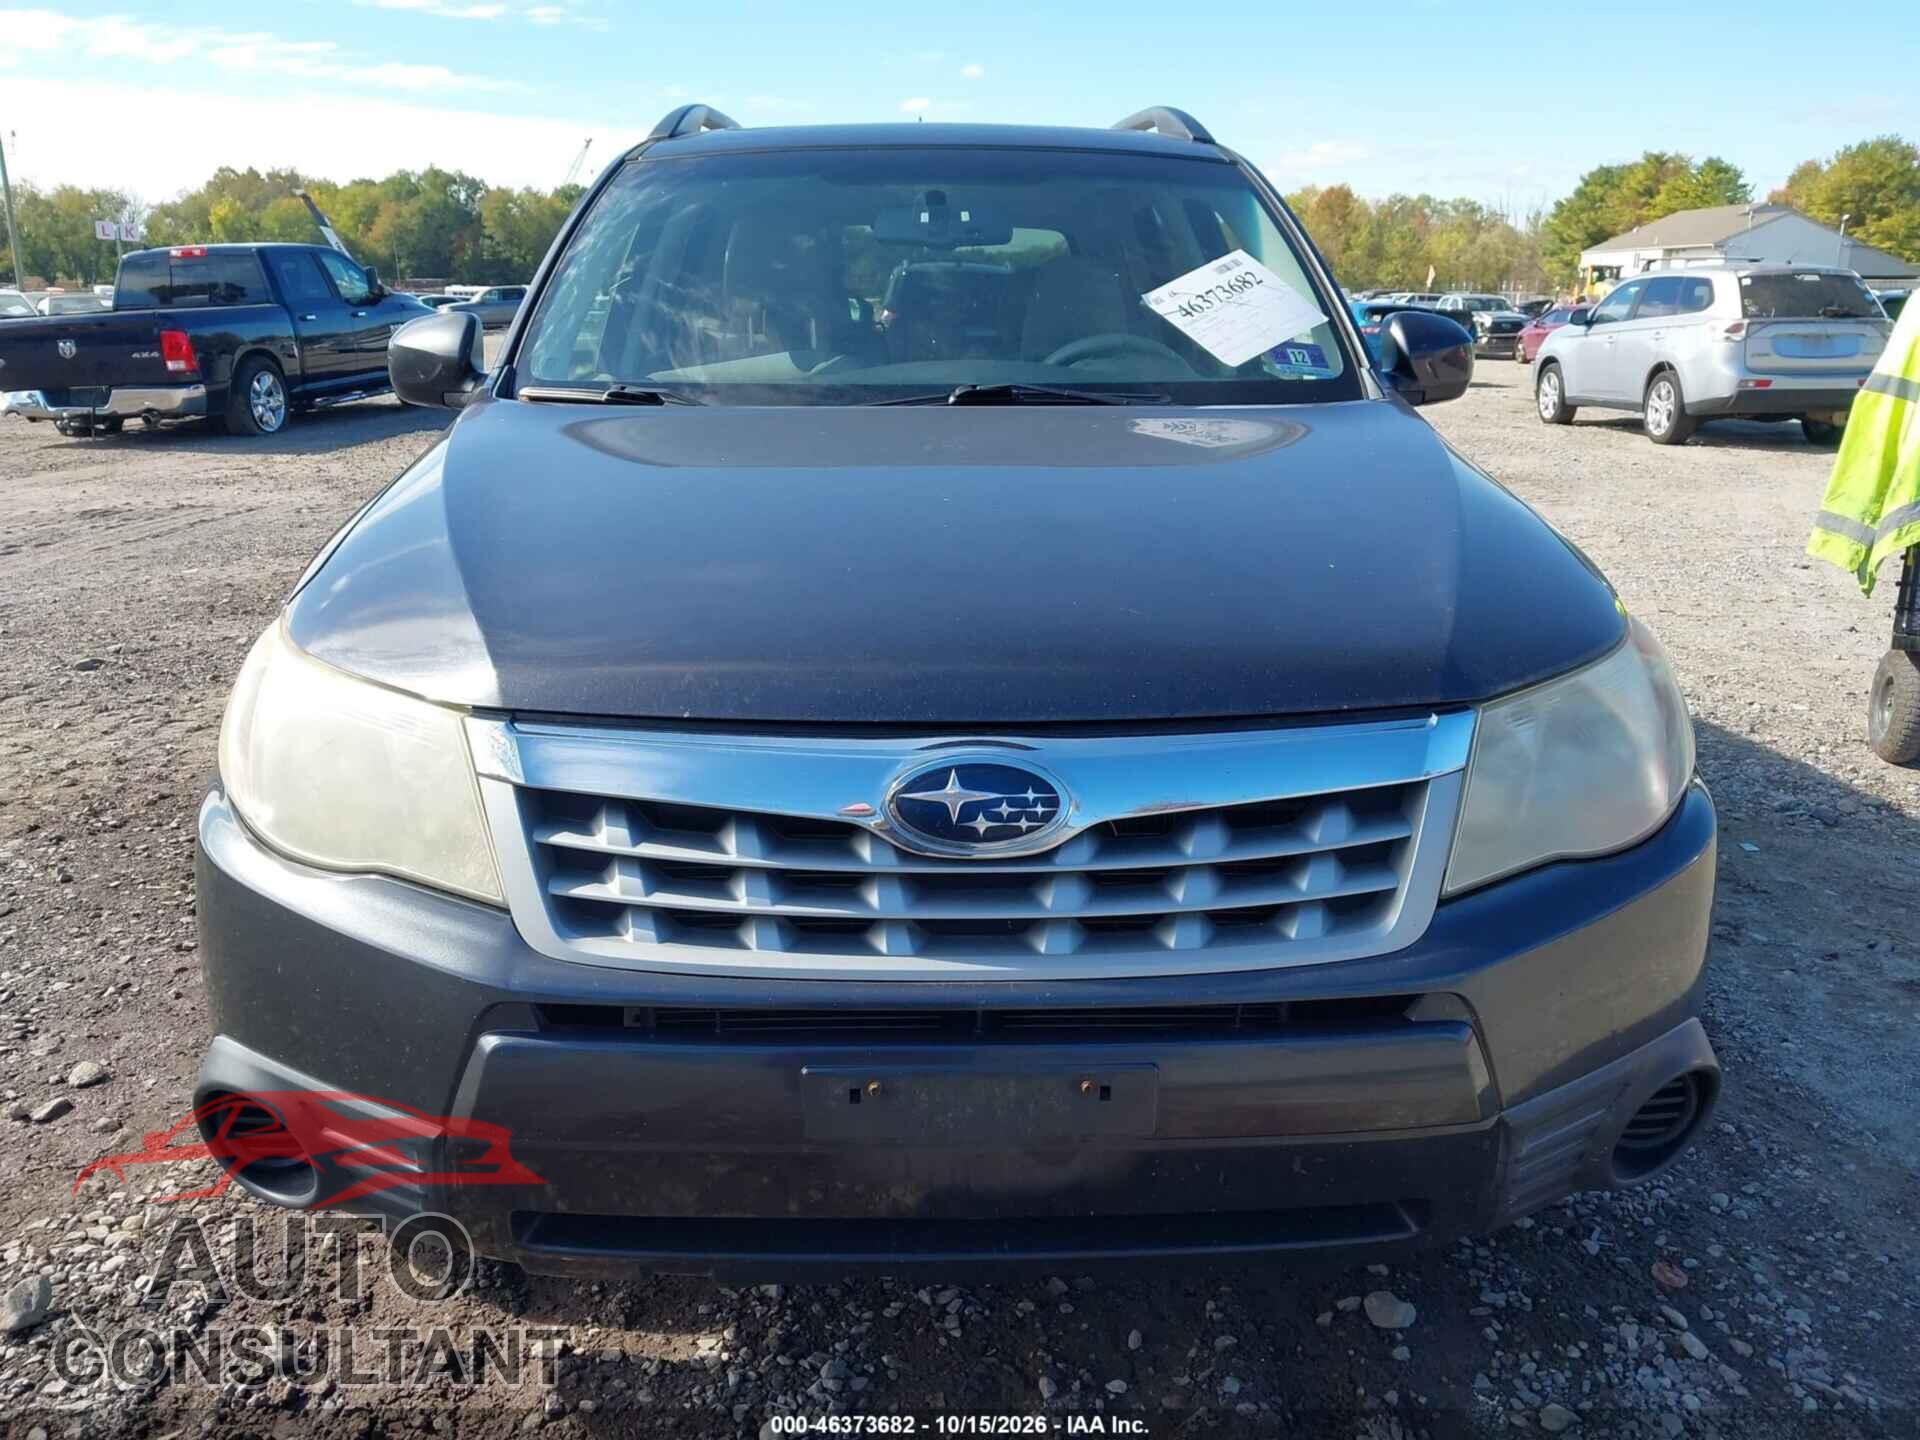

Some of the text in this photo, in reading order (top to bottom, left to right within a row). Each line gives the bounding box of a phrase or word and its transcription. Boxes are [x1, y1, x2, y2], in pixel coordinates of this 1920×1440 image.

[101, 224, 111, 237] L
[124, 224, 135, 239] K
[1178, 271, 1264, 318] 46373682
